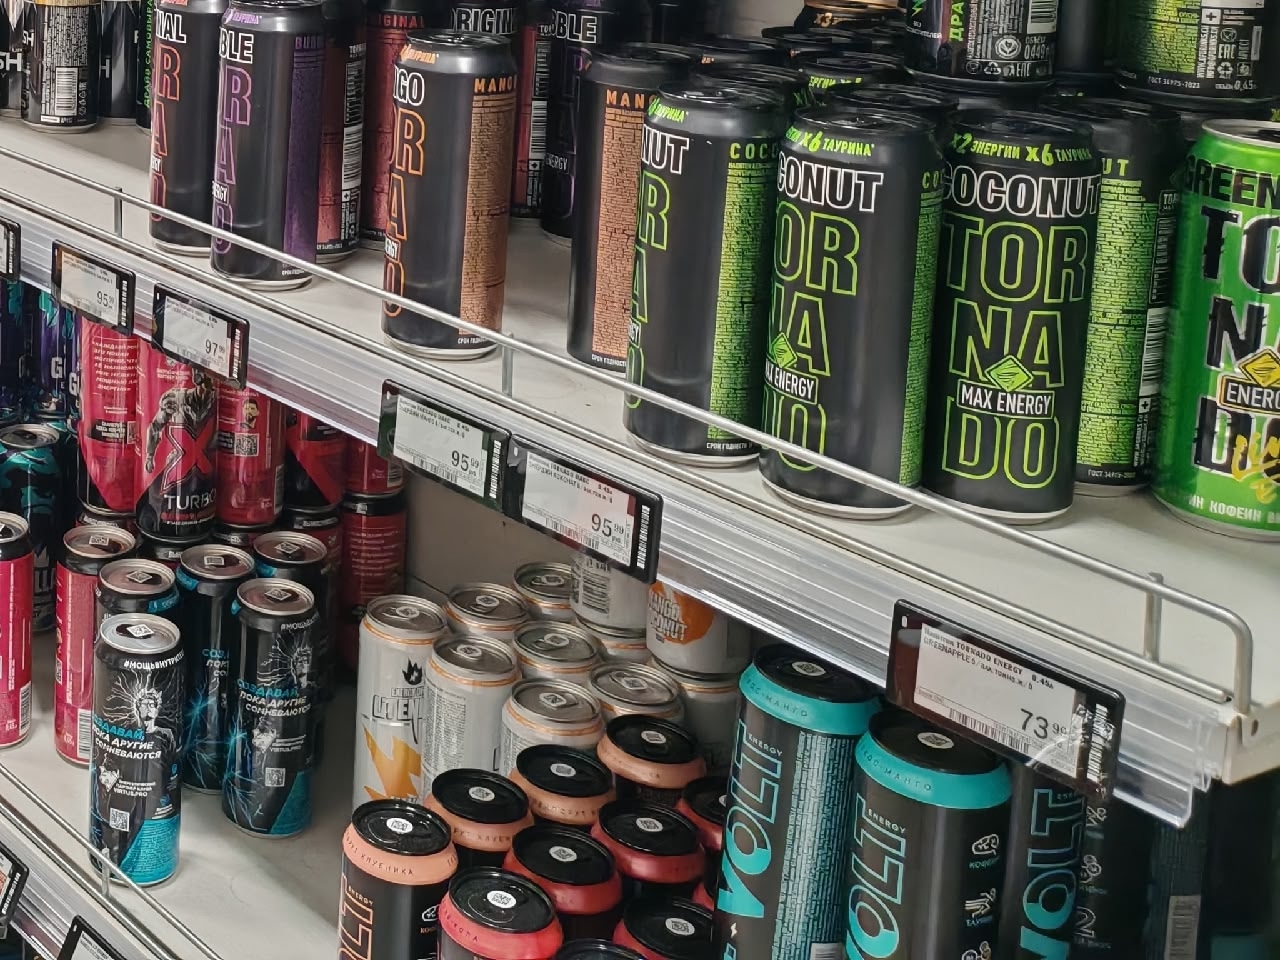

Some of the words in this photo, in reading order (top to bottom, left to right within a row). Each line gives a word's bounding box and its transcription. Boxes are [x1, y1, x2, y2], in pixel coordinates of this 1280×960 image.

[971, 139, 1020, 160] ЭНЕРГИИ
[941, 212, 1089, 304] TOR
[96, 290, 109, 308] 95
[205, 338, 219, 356] 97
[949, 297, 1064, 390] NA
[774, 366, 817, 401] ENERGY
[961, 386, 993, 411] MAX
[995, 392, 1053, 417] ENERGY
[941, 397, 1060, 490] DO
[451, 450, 469, 472] 95
[1210, 499, 1262, 523] КОФЕИН
[591, 513, 613, 538] 95
[956, 641, 992, 662] TORNADO
[993, 656, 1023, 676] ENERGY
[1020, 708, 1050, 740] 73
[95, 737, 162, 760] СОМНЕВАЮТСЯ
[111, 737, 154, 751] ДРУГИЕ
[748, 732, 784, 758] ENERGY
[717, 718, 783, 919] VOLT
[868, 808, 907, 835] ENERGY
